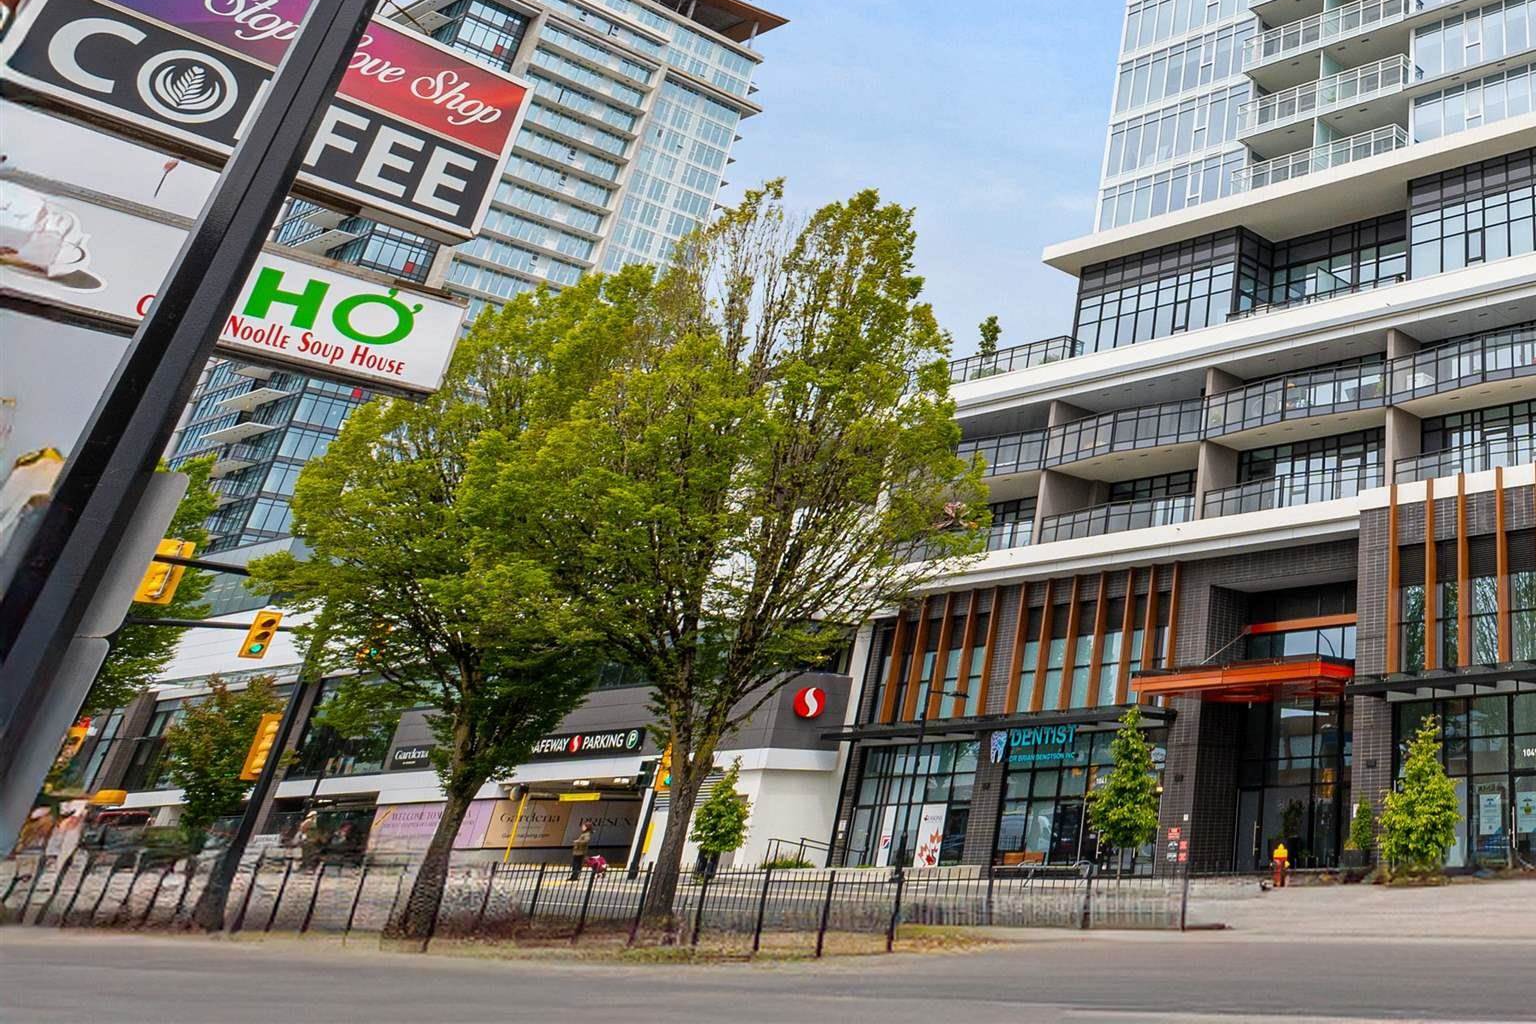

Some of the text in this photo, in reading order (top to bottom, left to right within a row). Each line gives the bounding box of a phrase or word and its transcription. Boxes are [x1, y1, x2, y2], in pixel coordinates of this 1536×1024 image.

[347, 34, 406, 83] ove
[410, 70, 502, 125] Shop
[47, 17, 478, 217] COFEE
[582, 733, 625, 750] PARKING
[1010, 725, 1077, 747] DENTIST
